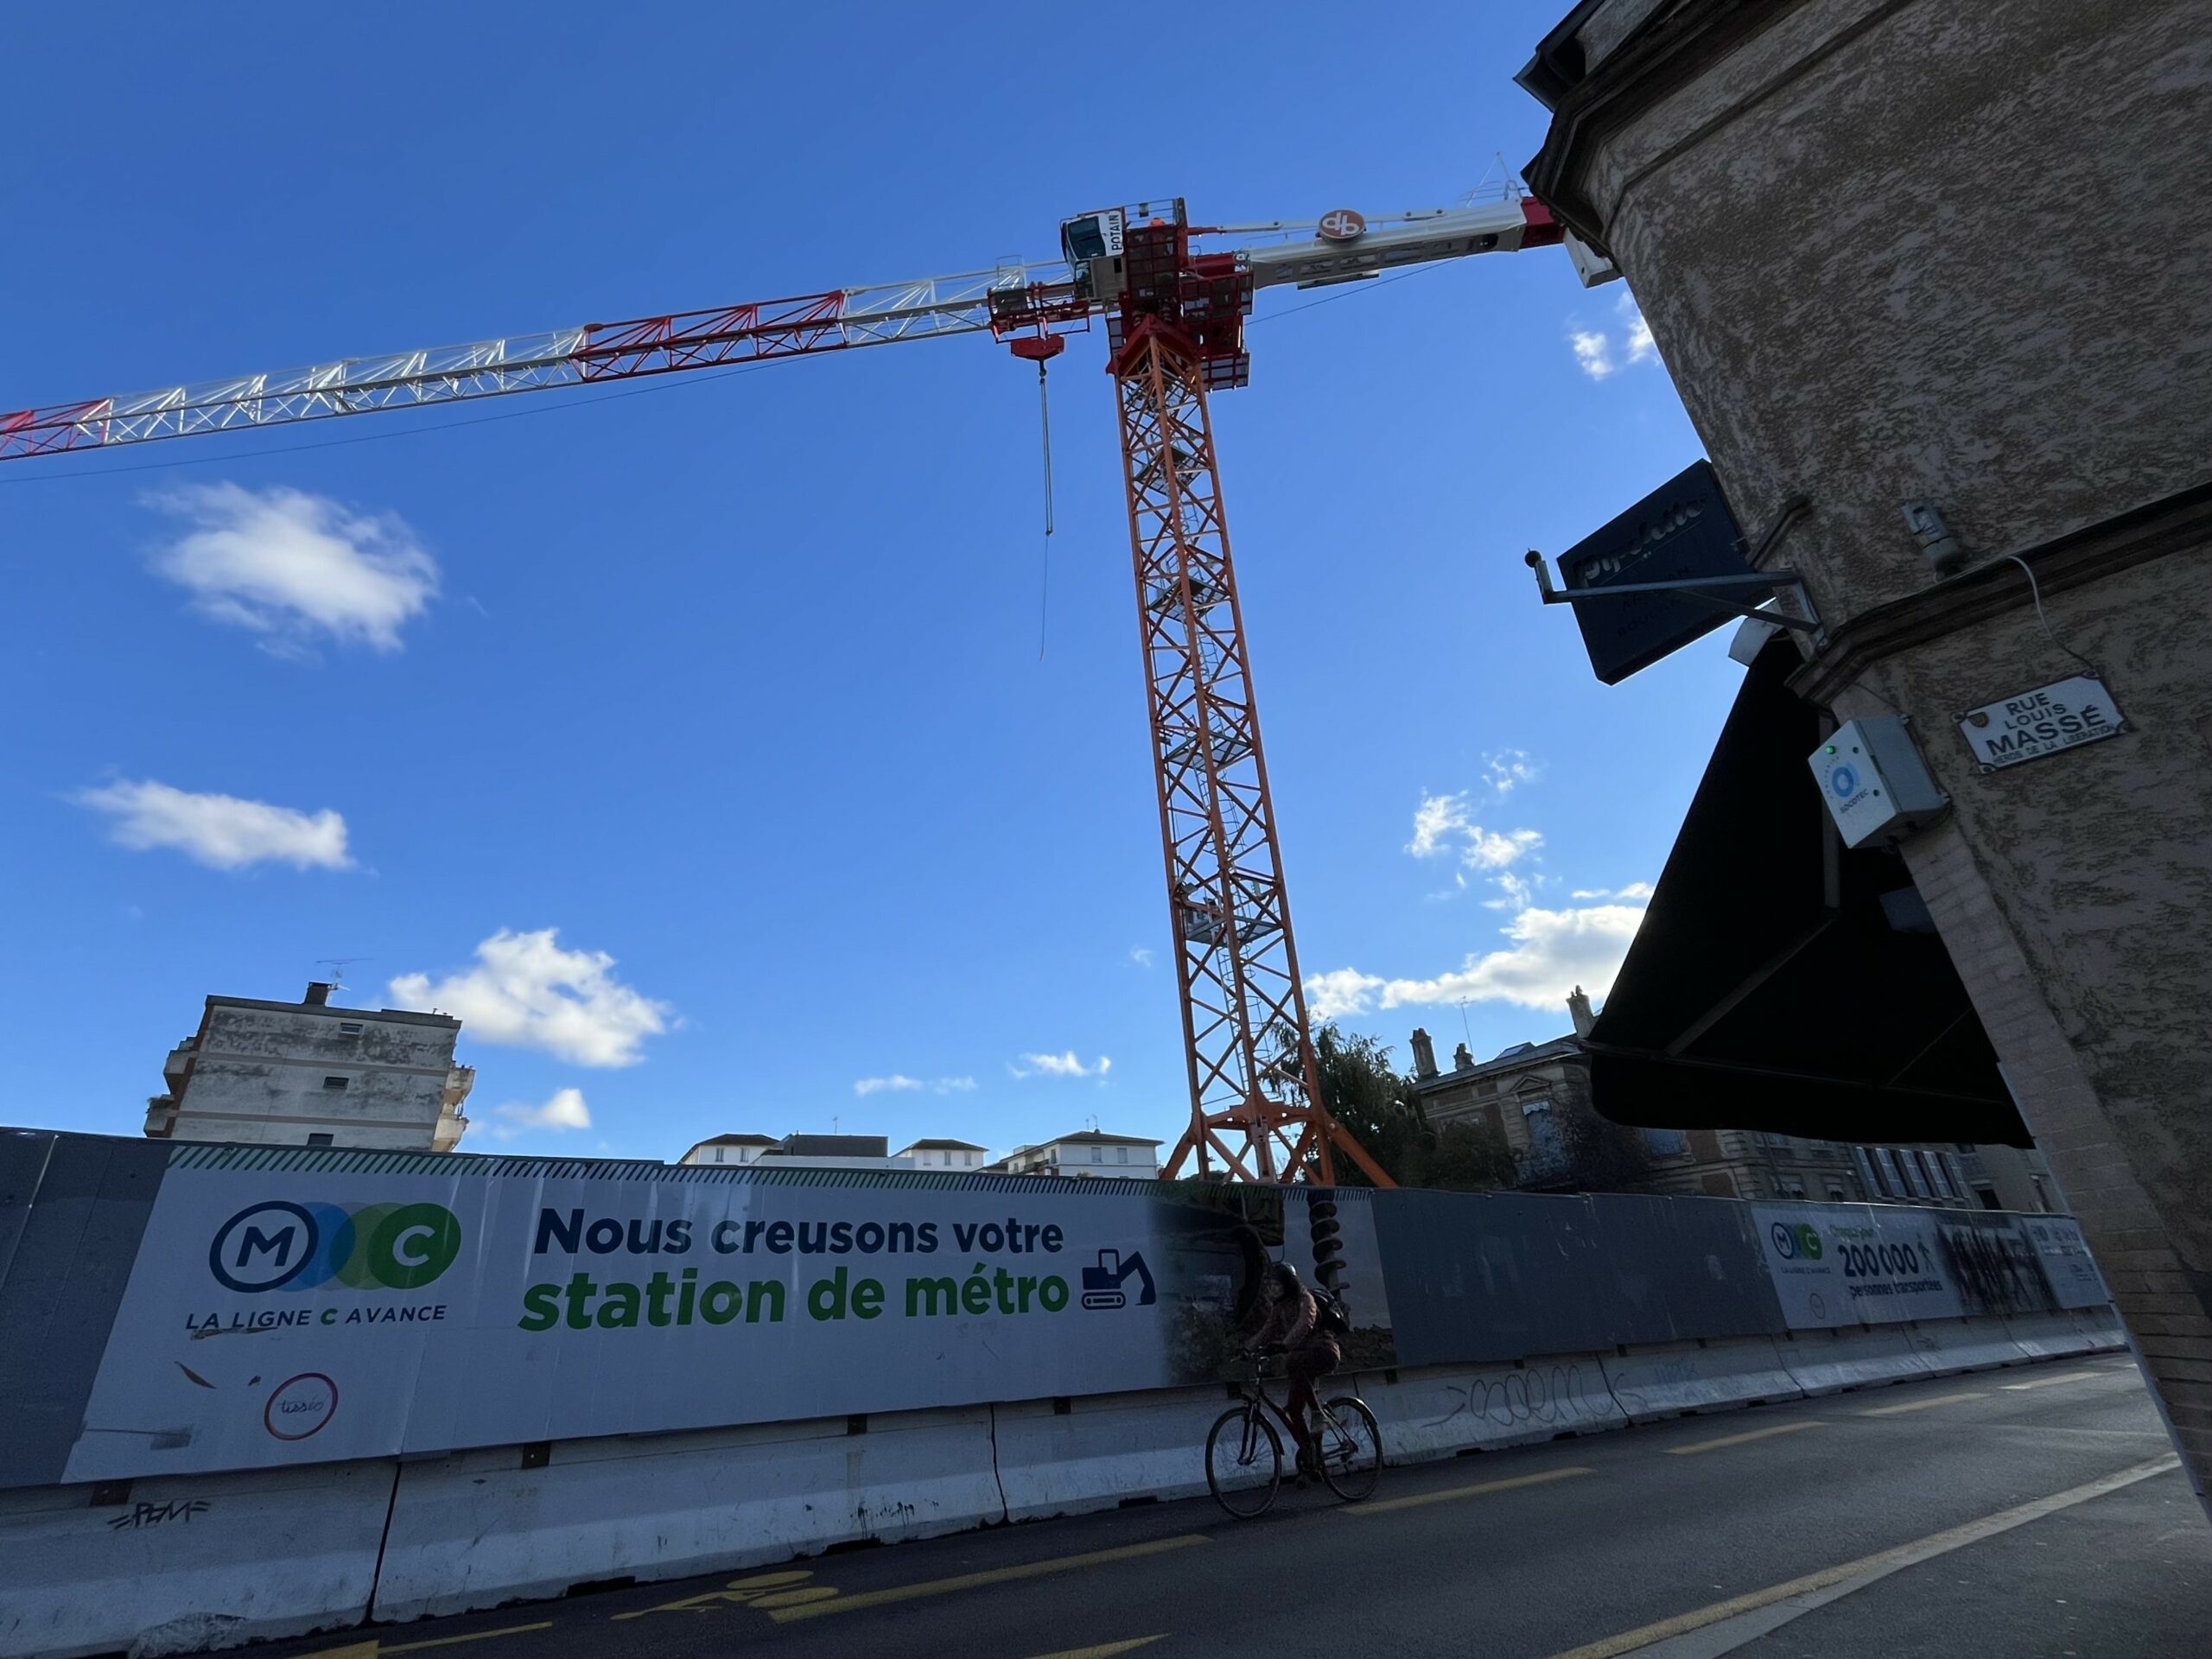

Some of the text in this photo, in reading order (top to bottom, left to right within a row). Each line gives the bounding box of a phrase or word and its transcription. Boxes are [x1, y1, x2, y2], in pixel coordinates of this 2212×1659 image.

[1108, 213, 1122, 251] POTAIN
[1322, 212, 1360, 236] db
[2004, 703, 2067, 730] LOUIS
[2005, 692, 2050, 715] RUE
[1986, 704, 2107, 756] MASSÉ
[2025, 746, 2040, 755] DE
[2044, 741, 2057, 750] LA
[1839, 788, 1871, 814] SOCOTEC
[533, 1207, 1065, 1255] Nous creusons votre
[235, 1224, 436, 1268] M C
[517, 1262, 1071, 1332] station de métro
[185, 1305, 448, 1330] LA LIGNE C AVANCE
